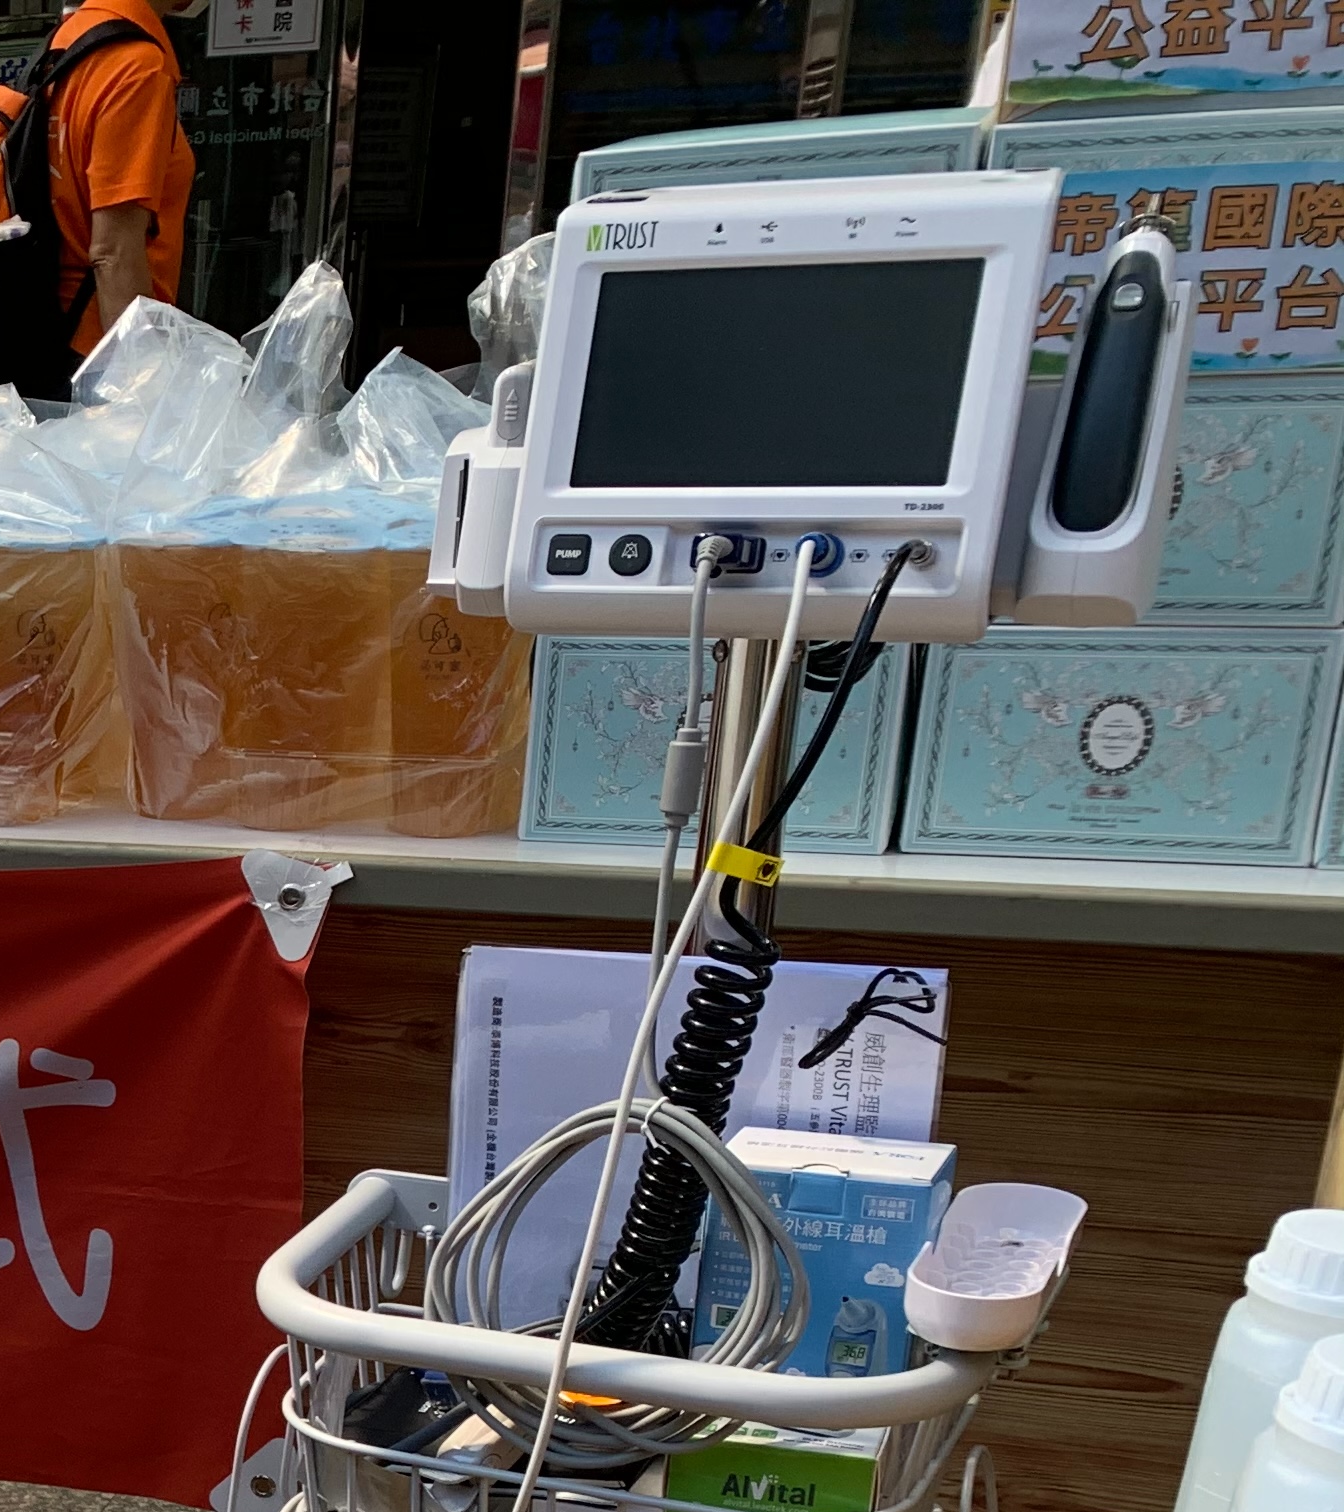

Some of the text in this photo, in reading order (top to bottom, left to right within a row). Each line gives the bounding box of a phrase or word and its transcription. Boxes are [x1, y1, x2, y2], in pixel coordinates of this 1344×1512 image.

[1080, 0, 1344, 63] 公益平
[1034, 265, 1344, 341] 公平台
[555, 548, 583, 560] PUMP
[721, 1473, 816, 1507] Alvital
